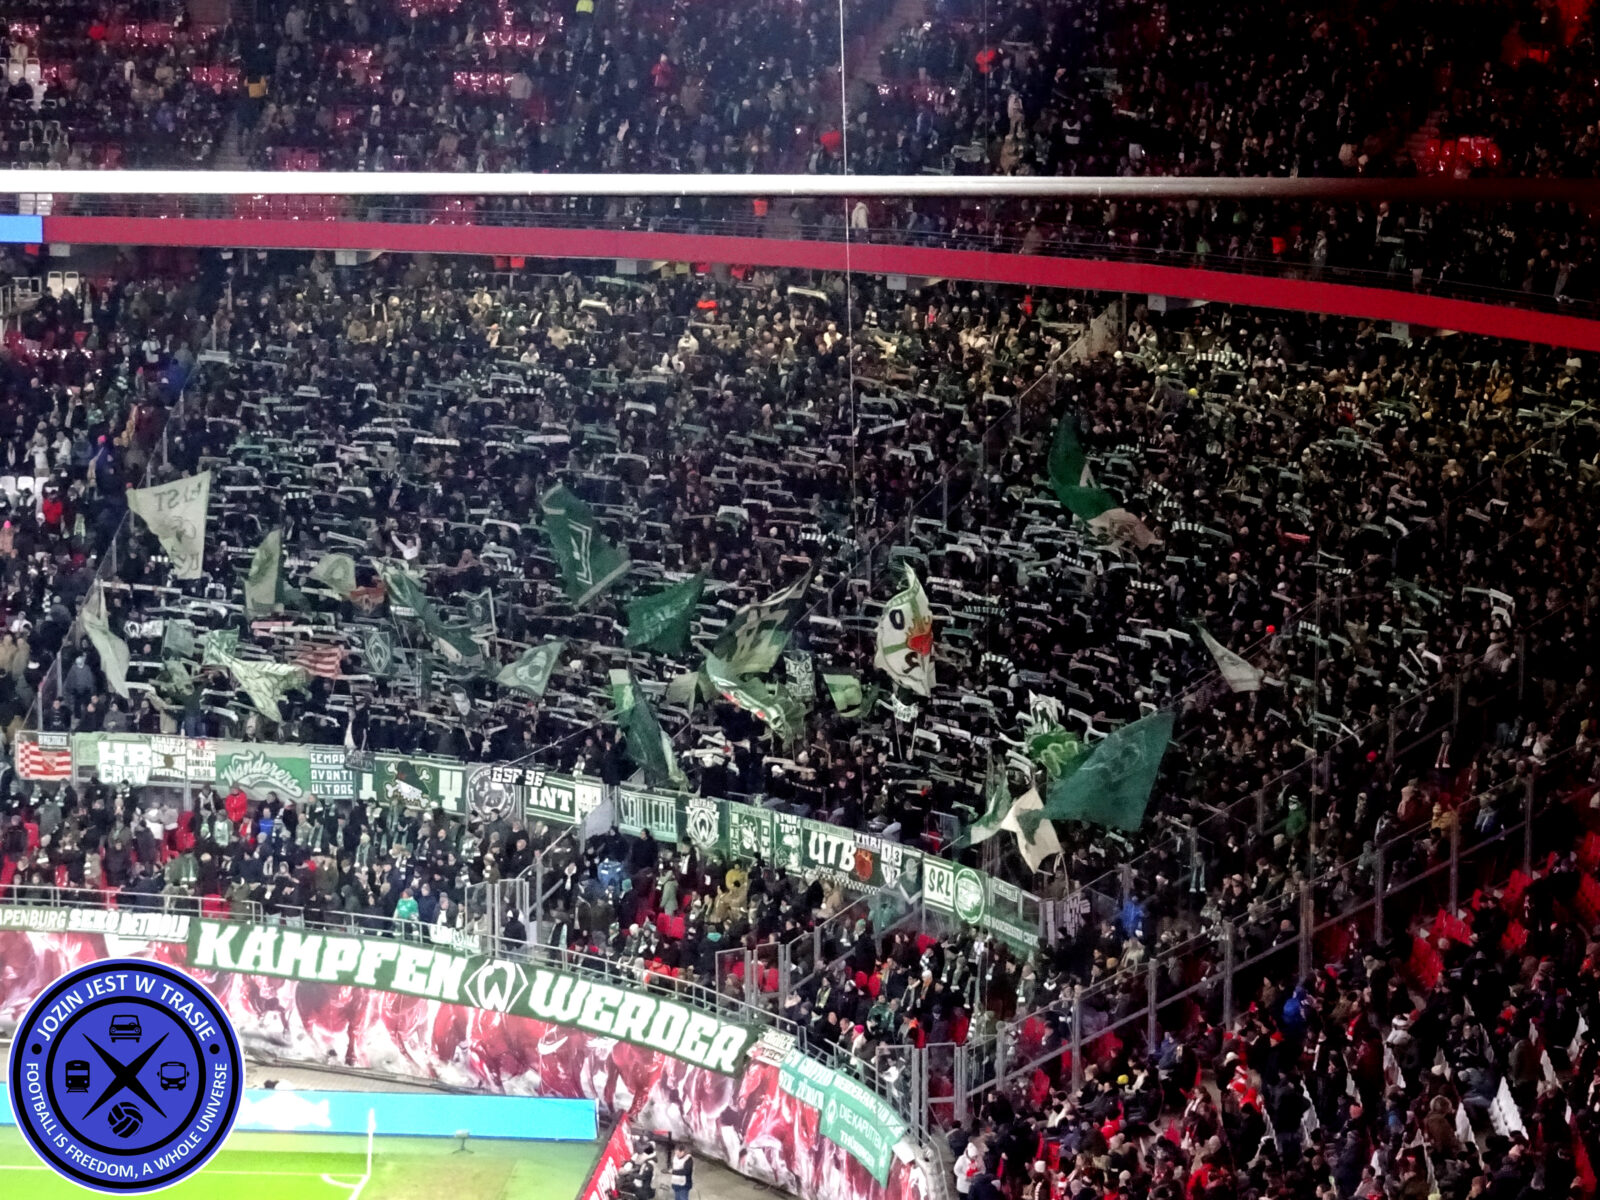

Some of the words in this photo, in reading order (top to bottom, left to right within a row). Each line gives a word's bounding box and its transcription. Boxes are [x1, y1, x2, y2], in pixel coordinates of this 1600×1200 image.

[100, 764, 151, 785] CREW
[311, 769, 353, 781] AVANTI
[492, 767, 523, 783] GSF
[524, 769, 545, 787] 96
[311, 783, 354, 795] ULTRAS
[529, 786, 572, 812] INT
[808, 830, 856, 872] UTB
[928, 867, 951, 898] SRL
[194, 920, 469, 1001] KÄMPFEN
[528, 969, 749, 1074] WERDER
